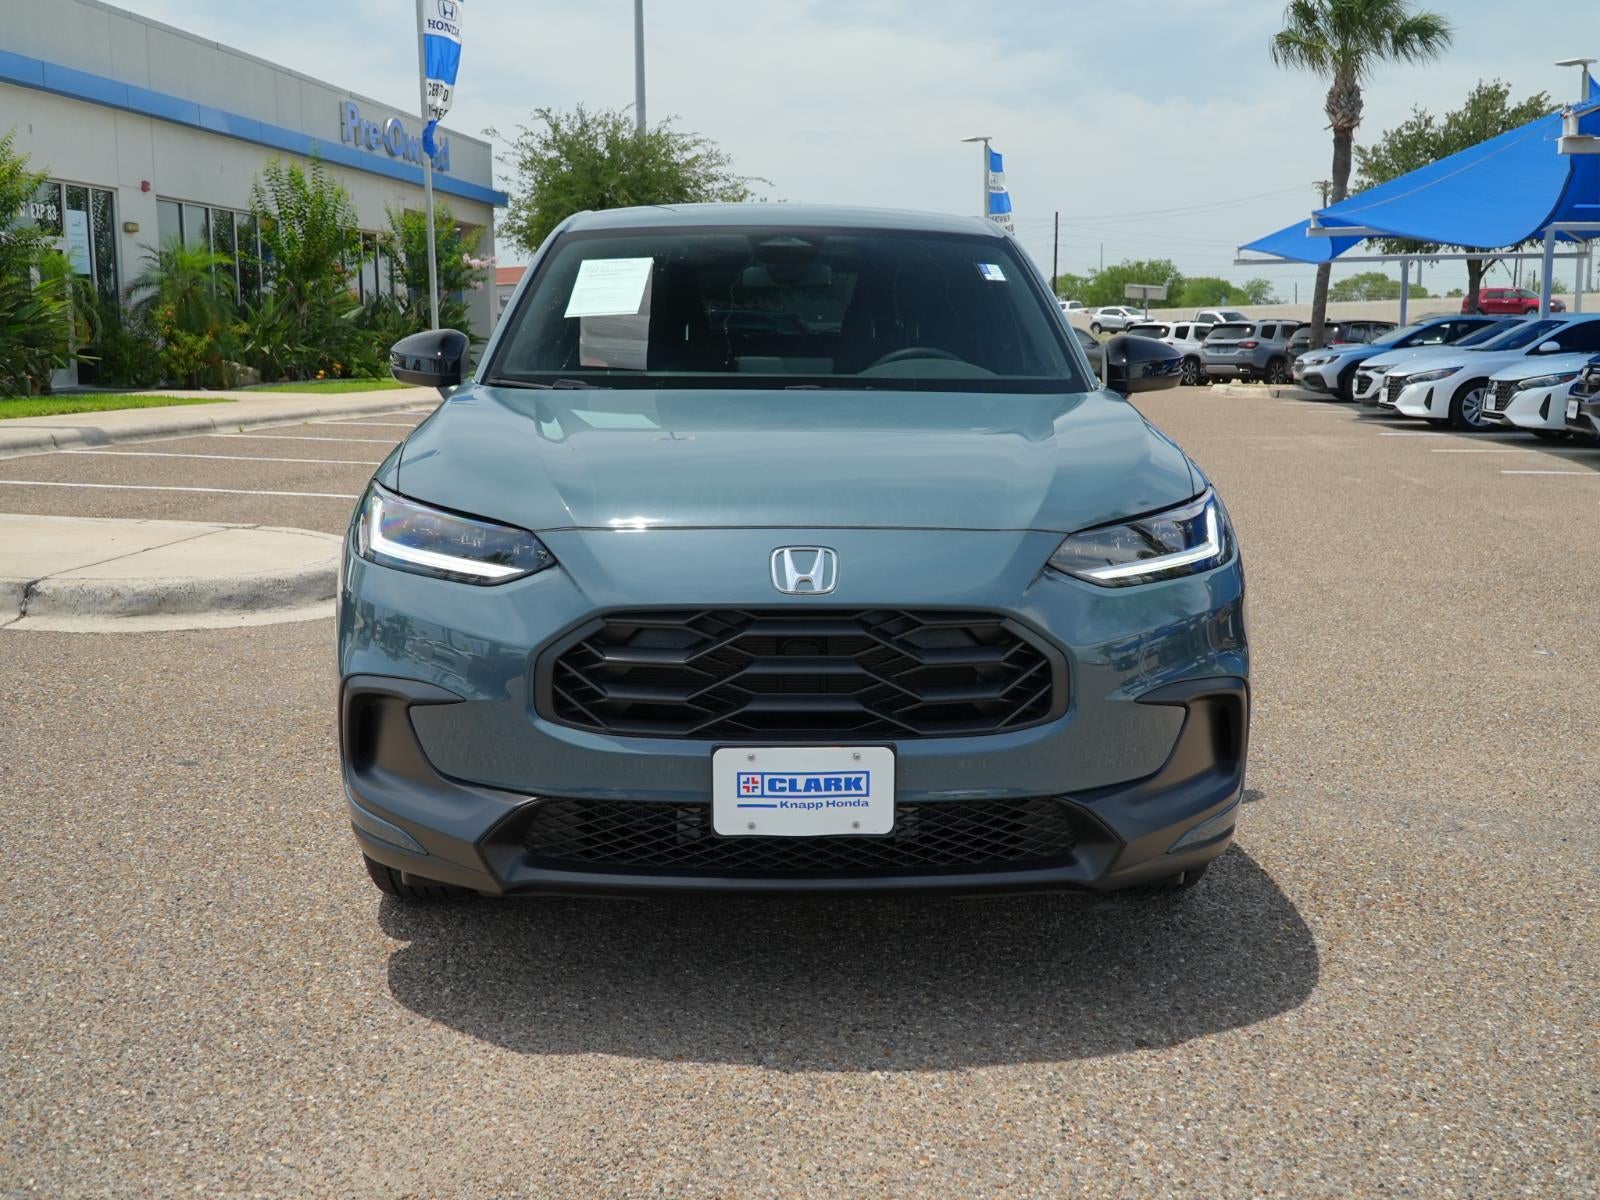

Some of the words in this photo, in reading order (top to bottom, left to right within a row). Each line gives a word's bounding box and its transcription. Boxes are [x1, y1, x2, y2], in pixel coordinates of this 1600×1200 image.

[427, 18, 460, 37] HONDA
[767, 776, 863, 793] CLARK
[779, 800, 823, 811] Knapp
[826, 799, 869, 808] Honda
